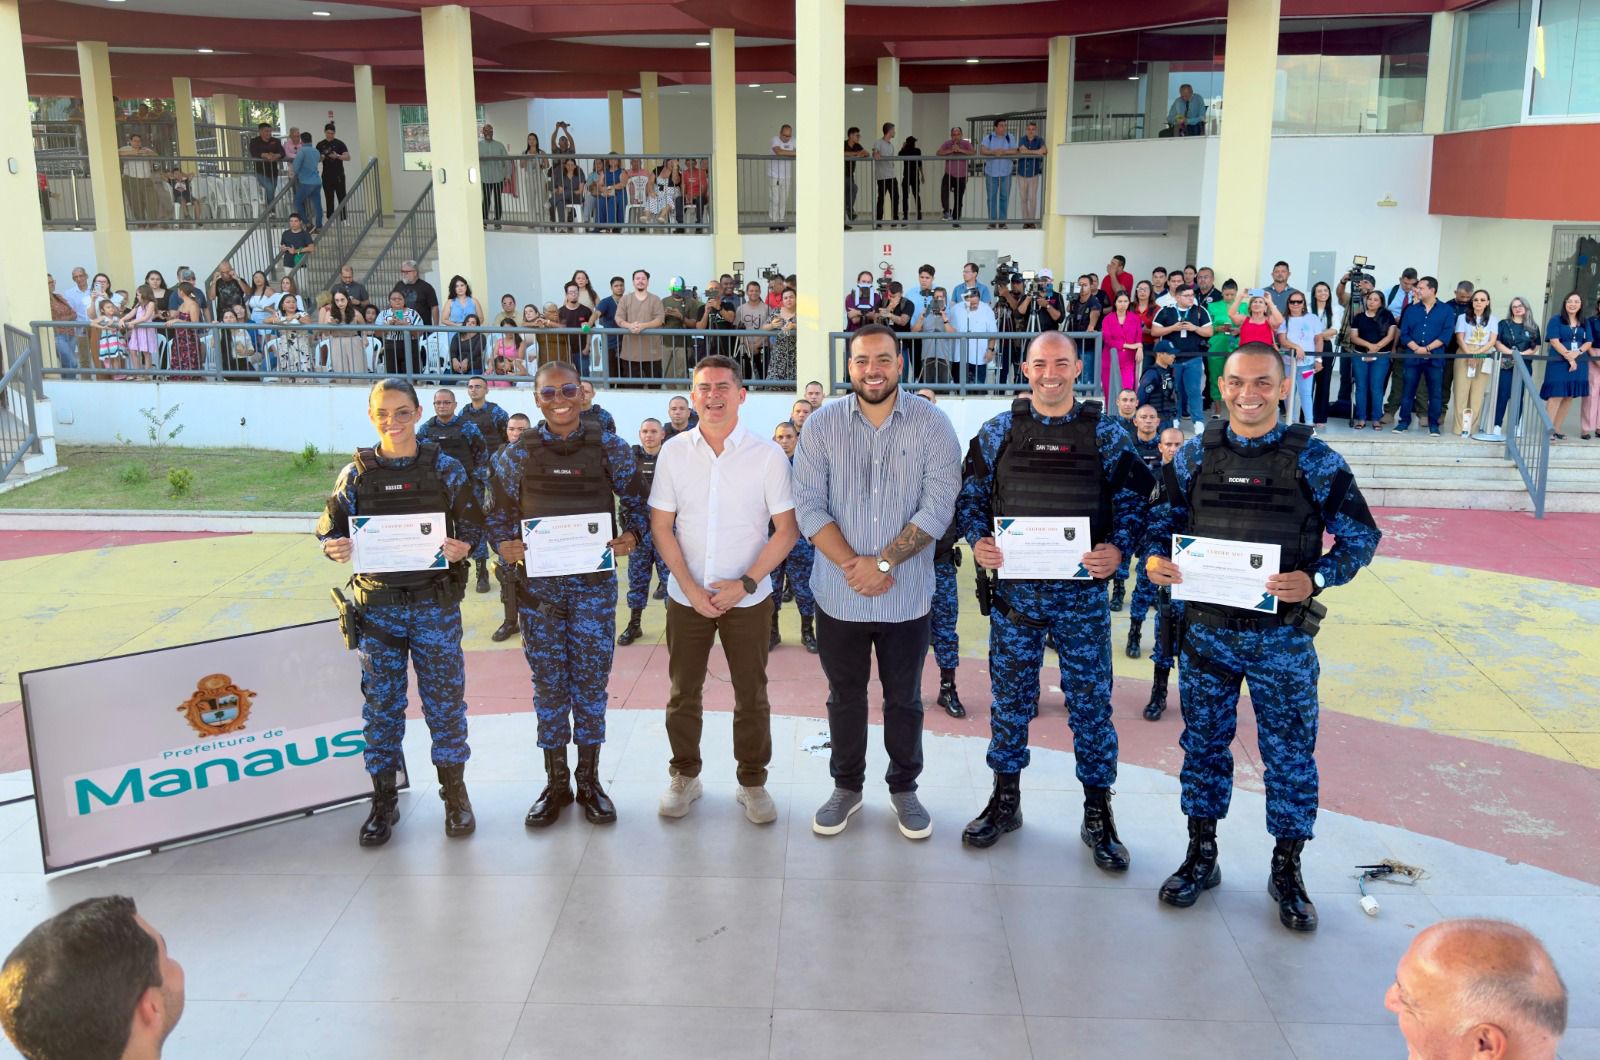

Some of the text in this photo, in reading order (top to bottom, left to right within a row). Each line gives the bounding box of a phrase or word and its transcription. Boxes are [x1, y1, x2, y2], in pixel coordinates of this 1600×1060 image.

[74, 729, 367, 815] Manaus
[163, 729, 284, 760] Prefeitura de
